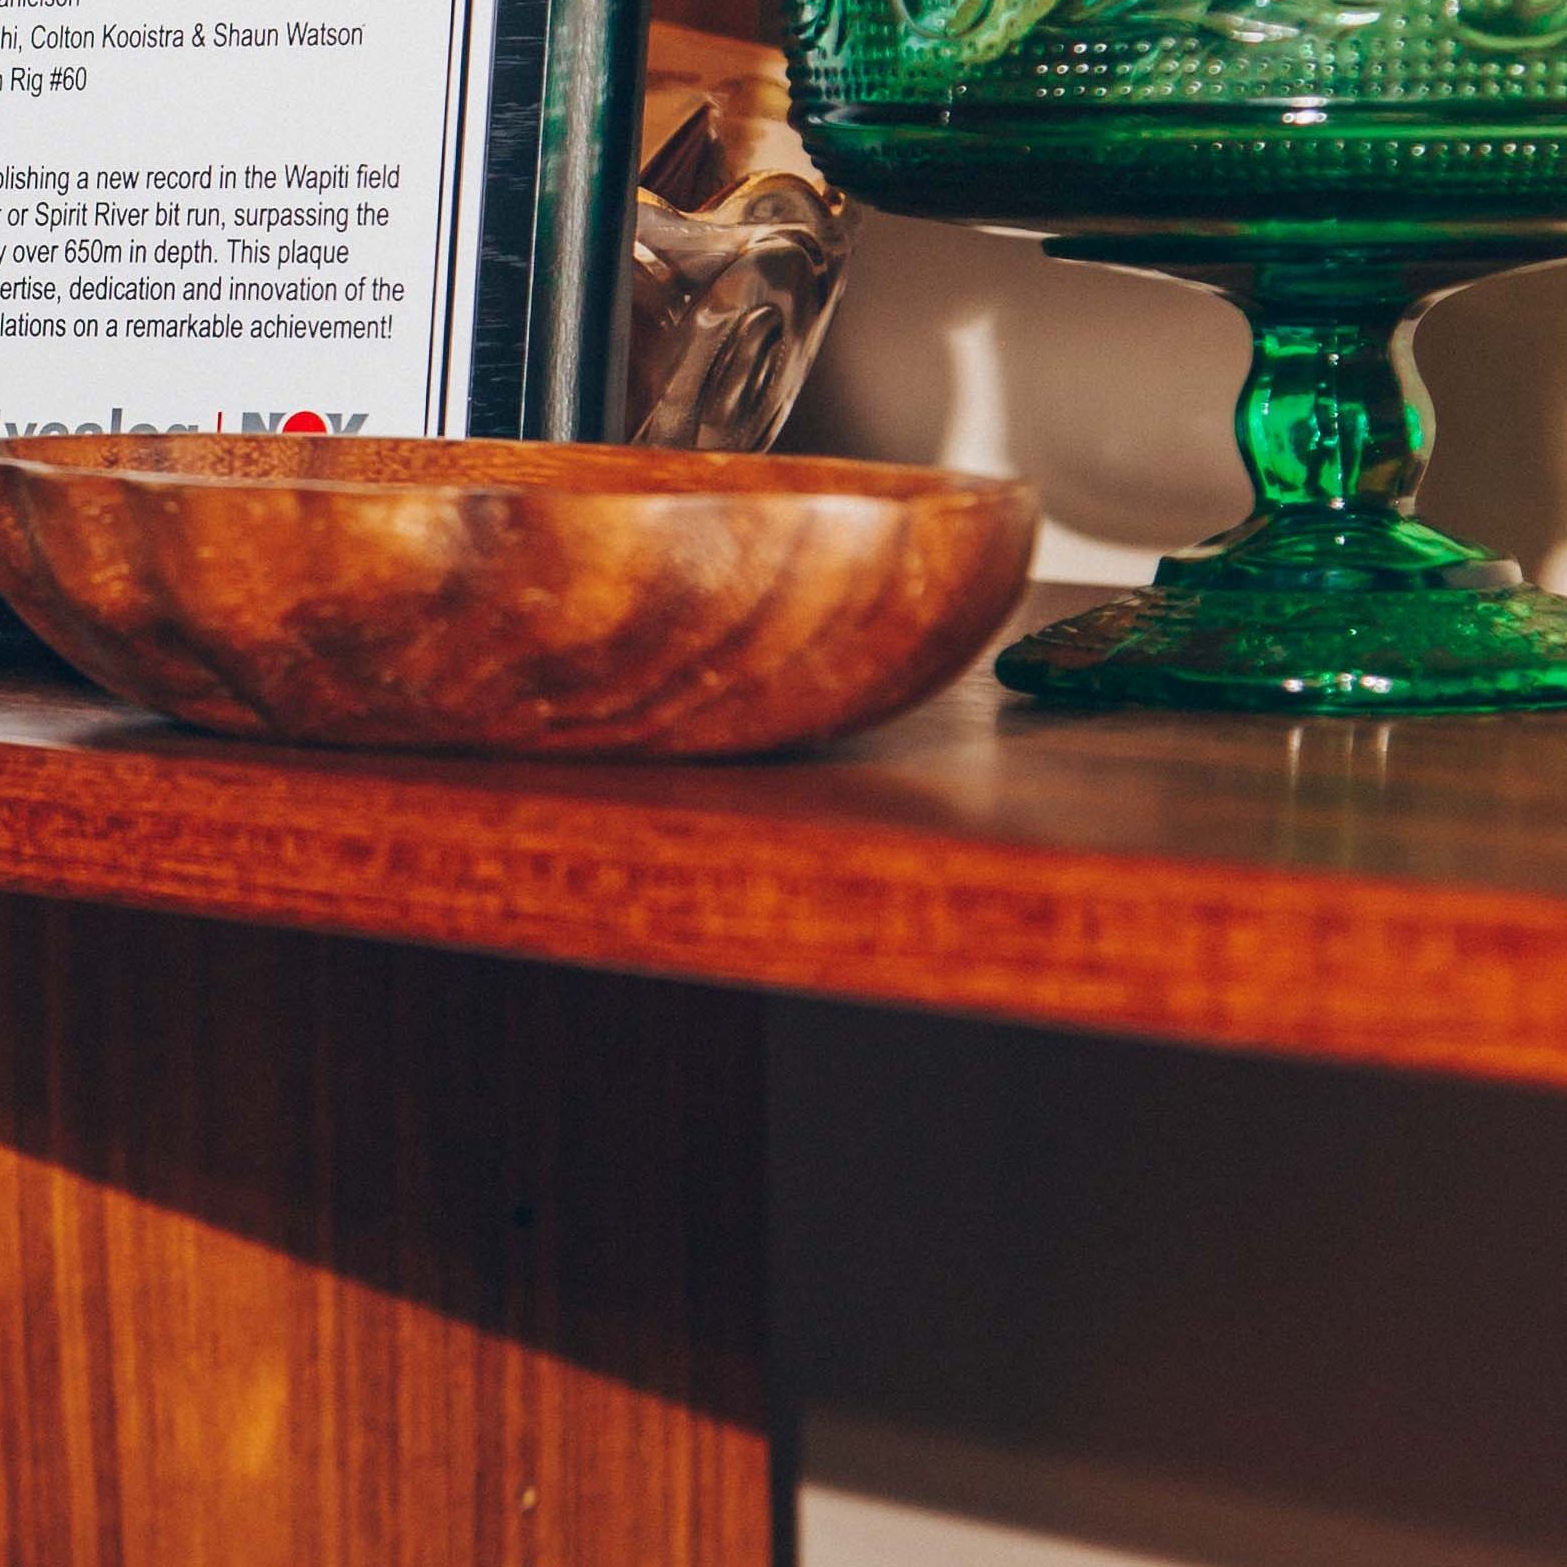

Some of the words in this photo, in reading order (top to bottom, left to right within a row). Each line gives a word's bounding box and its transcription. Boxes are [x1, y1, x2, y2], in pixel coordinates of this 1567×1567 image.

[29, 23, 96, 51] Colton
[100, 22, 185, 50] Kooistra
[190, 21, 207, 48] &
[212, 21, 280, 48] Shaun
[285, 20, 362, 47] Watson
[9, 66, 44, 99] Rig
[48, 65, 88, 93] #60
[75, 170, 90, 190] a
[95, 169, 140, 190] new
[144, 163, 213, 190] record
[218, 163, 238, 190] in
[243, 163, 278, 190] the
[283, 163, 350, 196] Wapiti
[355, 162, 401, 190] field
[6, 207, 30, 228] or
[34, 201, 89, 234] Spirit
[93, 201, 150, 228] River
[154, 201, 181, 228] bit
[185, 207, 226, 232] run,
[233, 201, 350, 234] surpassing
[355, 201, 390, 228] the
[11, 244, 60, 265] over
[63, 238, 123, 265] 650m
[128, 238, 148, 264] in
[152, 238, 219, 271] depth.
[225, 238, 271, 265] This
[276, 238, 350, 271] plaque
[68, 275, 177, 302] dedication
[181, 275, 223, 302] and
[228, 275, 338, 302] innovation
[343, 275, 368, 303] of
[371, 276, 406, 303] the
[72, 317, 100, 338] on
[104, 317, 119, 338] a
[124, 312, 244, 340] remarkable
[249, 313, 394, 340] achievement!
